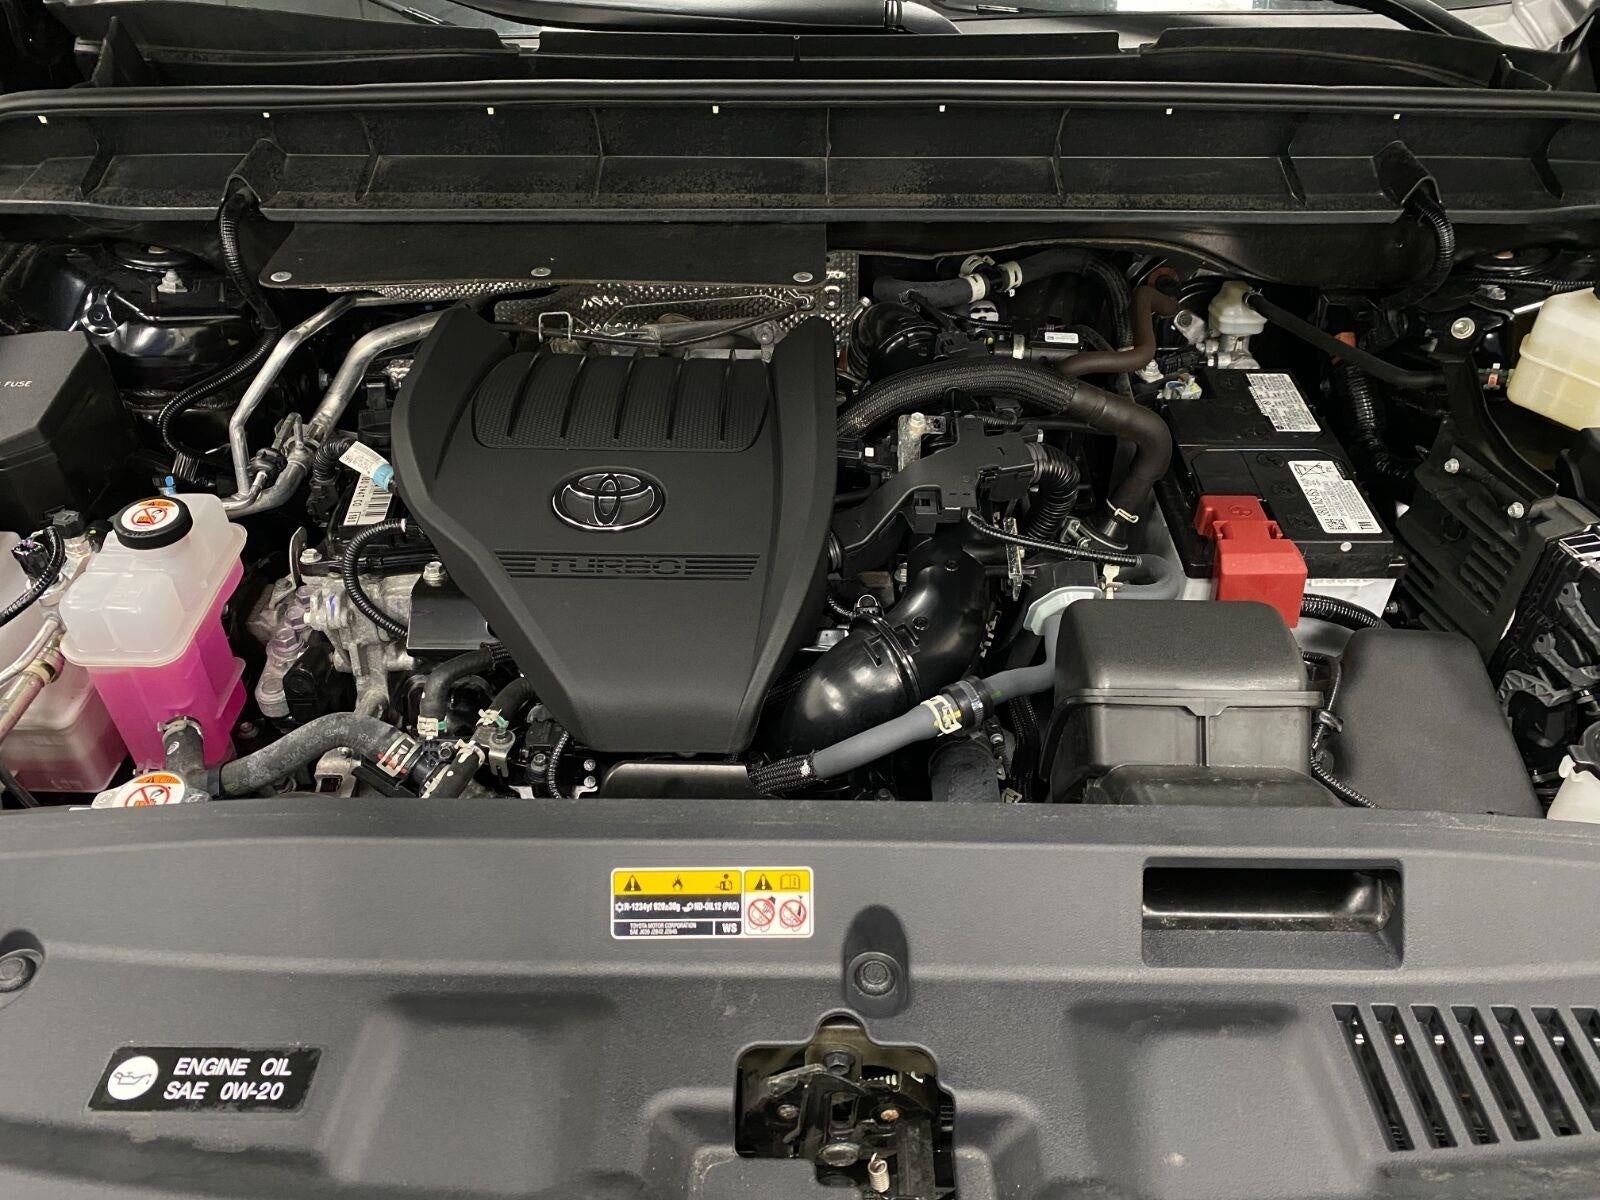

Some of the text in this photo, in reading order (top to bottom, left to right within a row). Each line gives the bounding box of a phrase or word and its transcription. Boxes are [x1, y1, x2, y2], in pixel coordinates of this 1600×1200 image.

[3, 380, 33, 388] FUSE
[533, 555, 682, 577] TURBO
[722, 922, 738, 934] WS
[173, 1057, 292, 1076] ENGINE OIL
[163, 1081, 285, 1101] SAE 0W-20
